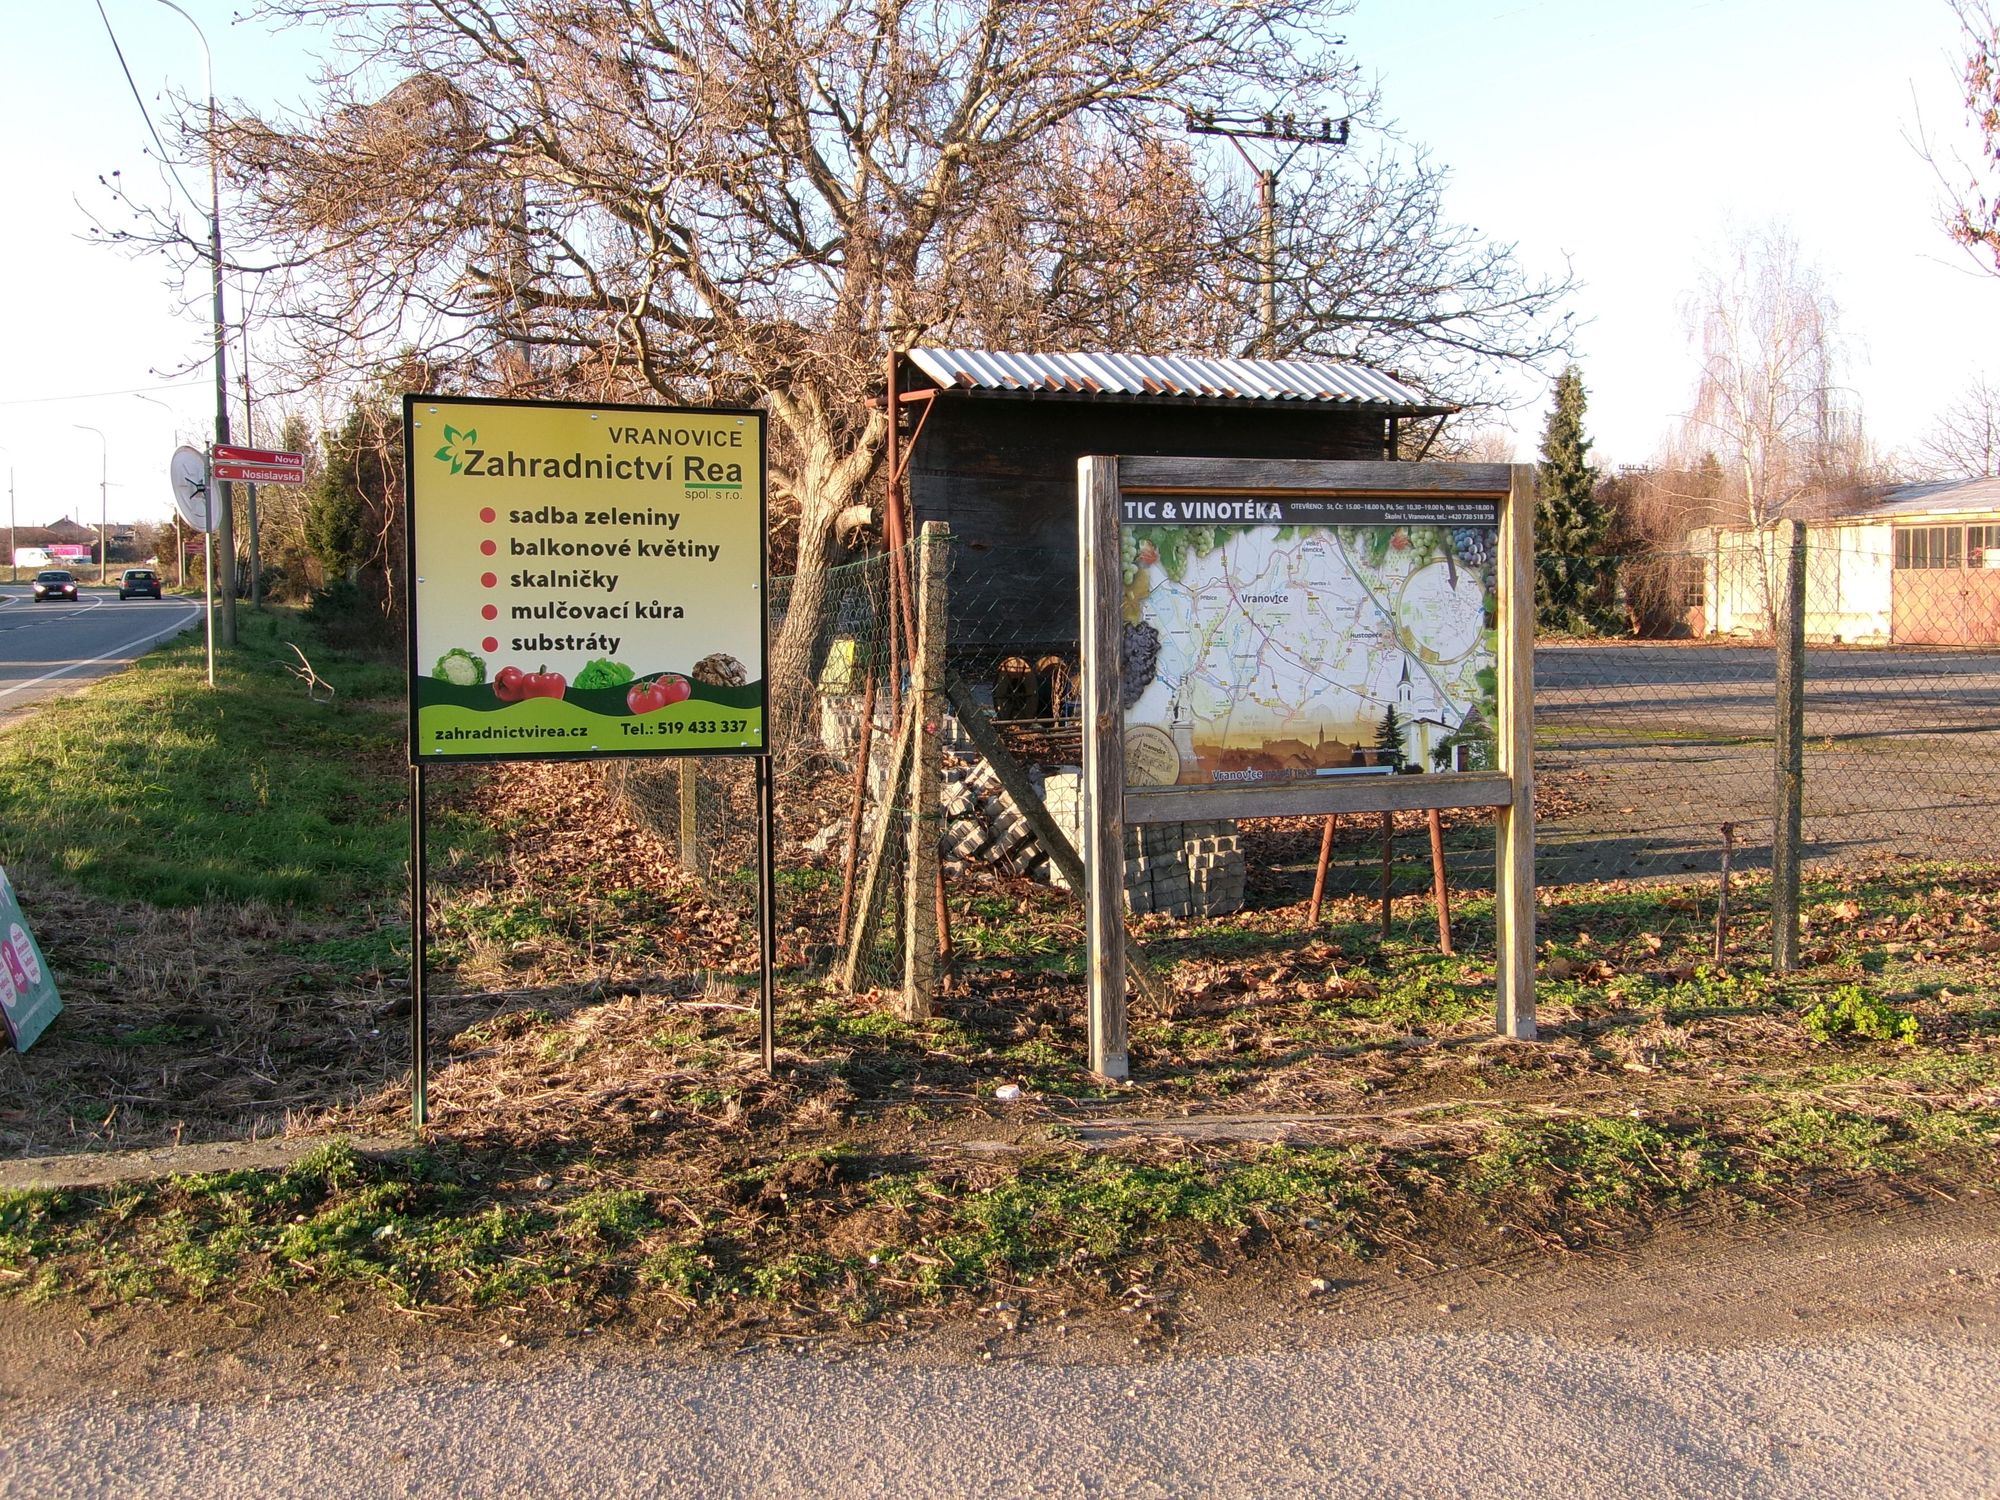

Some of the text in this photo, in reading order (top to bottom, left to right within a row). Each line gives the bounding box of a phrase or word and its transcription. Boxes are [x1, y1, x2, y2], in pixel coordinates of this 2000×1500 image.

[608, 426, 743, 448] VRANOVICE
[274, 455, 300, 464] Nová
[463, 449, 743, 482] Zahradnictví Rea
[242, 469, 301, 482] Nosislavská
[684, 488, 743, 501] spol. s r.o.
[1124, 499, 1283, 519] TIC & VINOTÉKA
[1290, 502, 1324, 510] OTEVŘENO:
[509, 506, 681, 530] sadba zeleniny
[510, 538, 720, 562] balkonové květiny
[510, 569, 619, 592] skalničky
[1241, 592, 1289, 604] Vranovice
[511, 600, 685, 620] mulčovací kůra
[511, 633, 621, 655] substráty
[435, 720, 748, 740] zahradnictvirea.cz Tel.: 519 433 337
[1212, 767, 1263, 781] Vranovice
